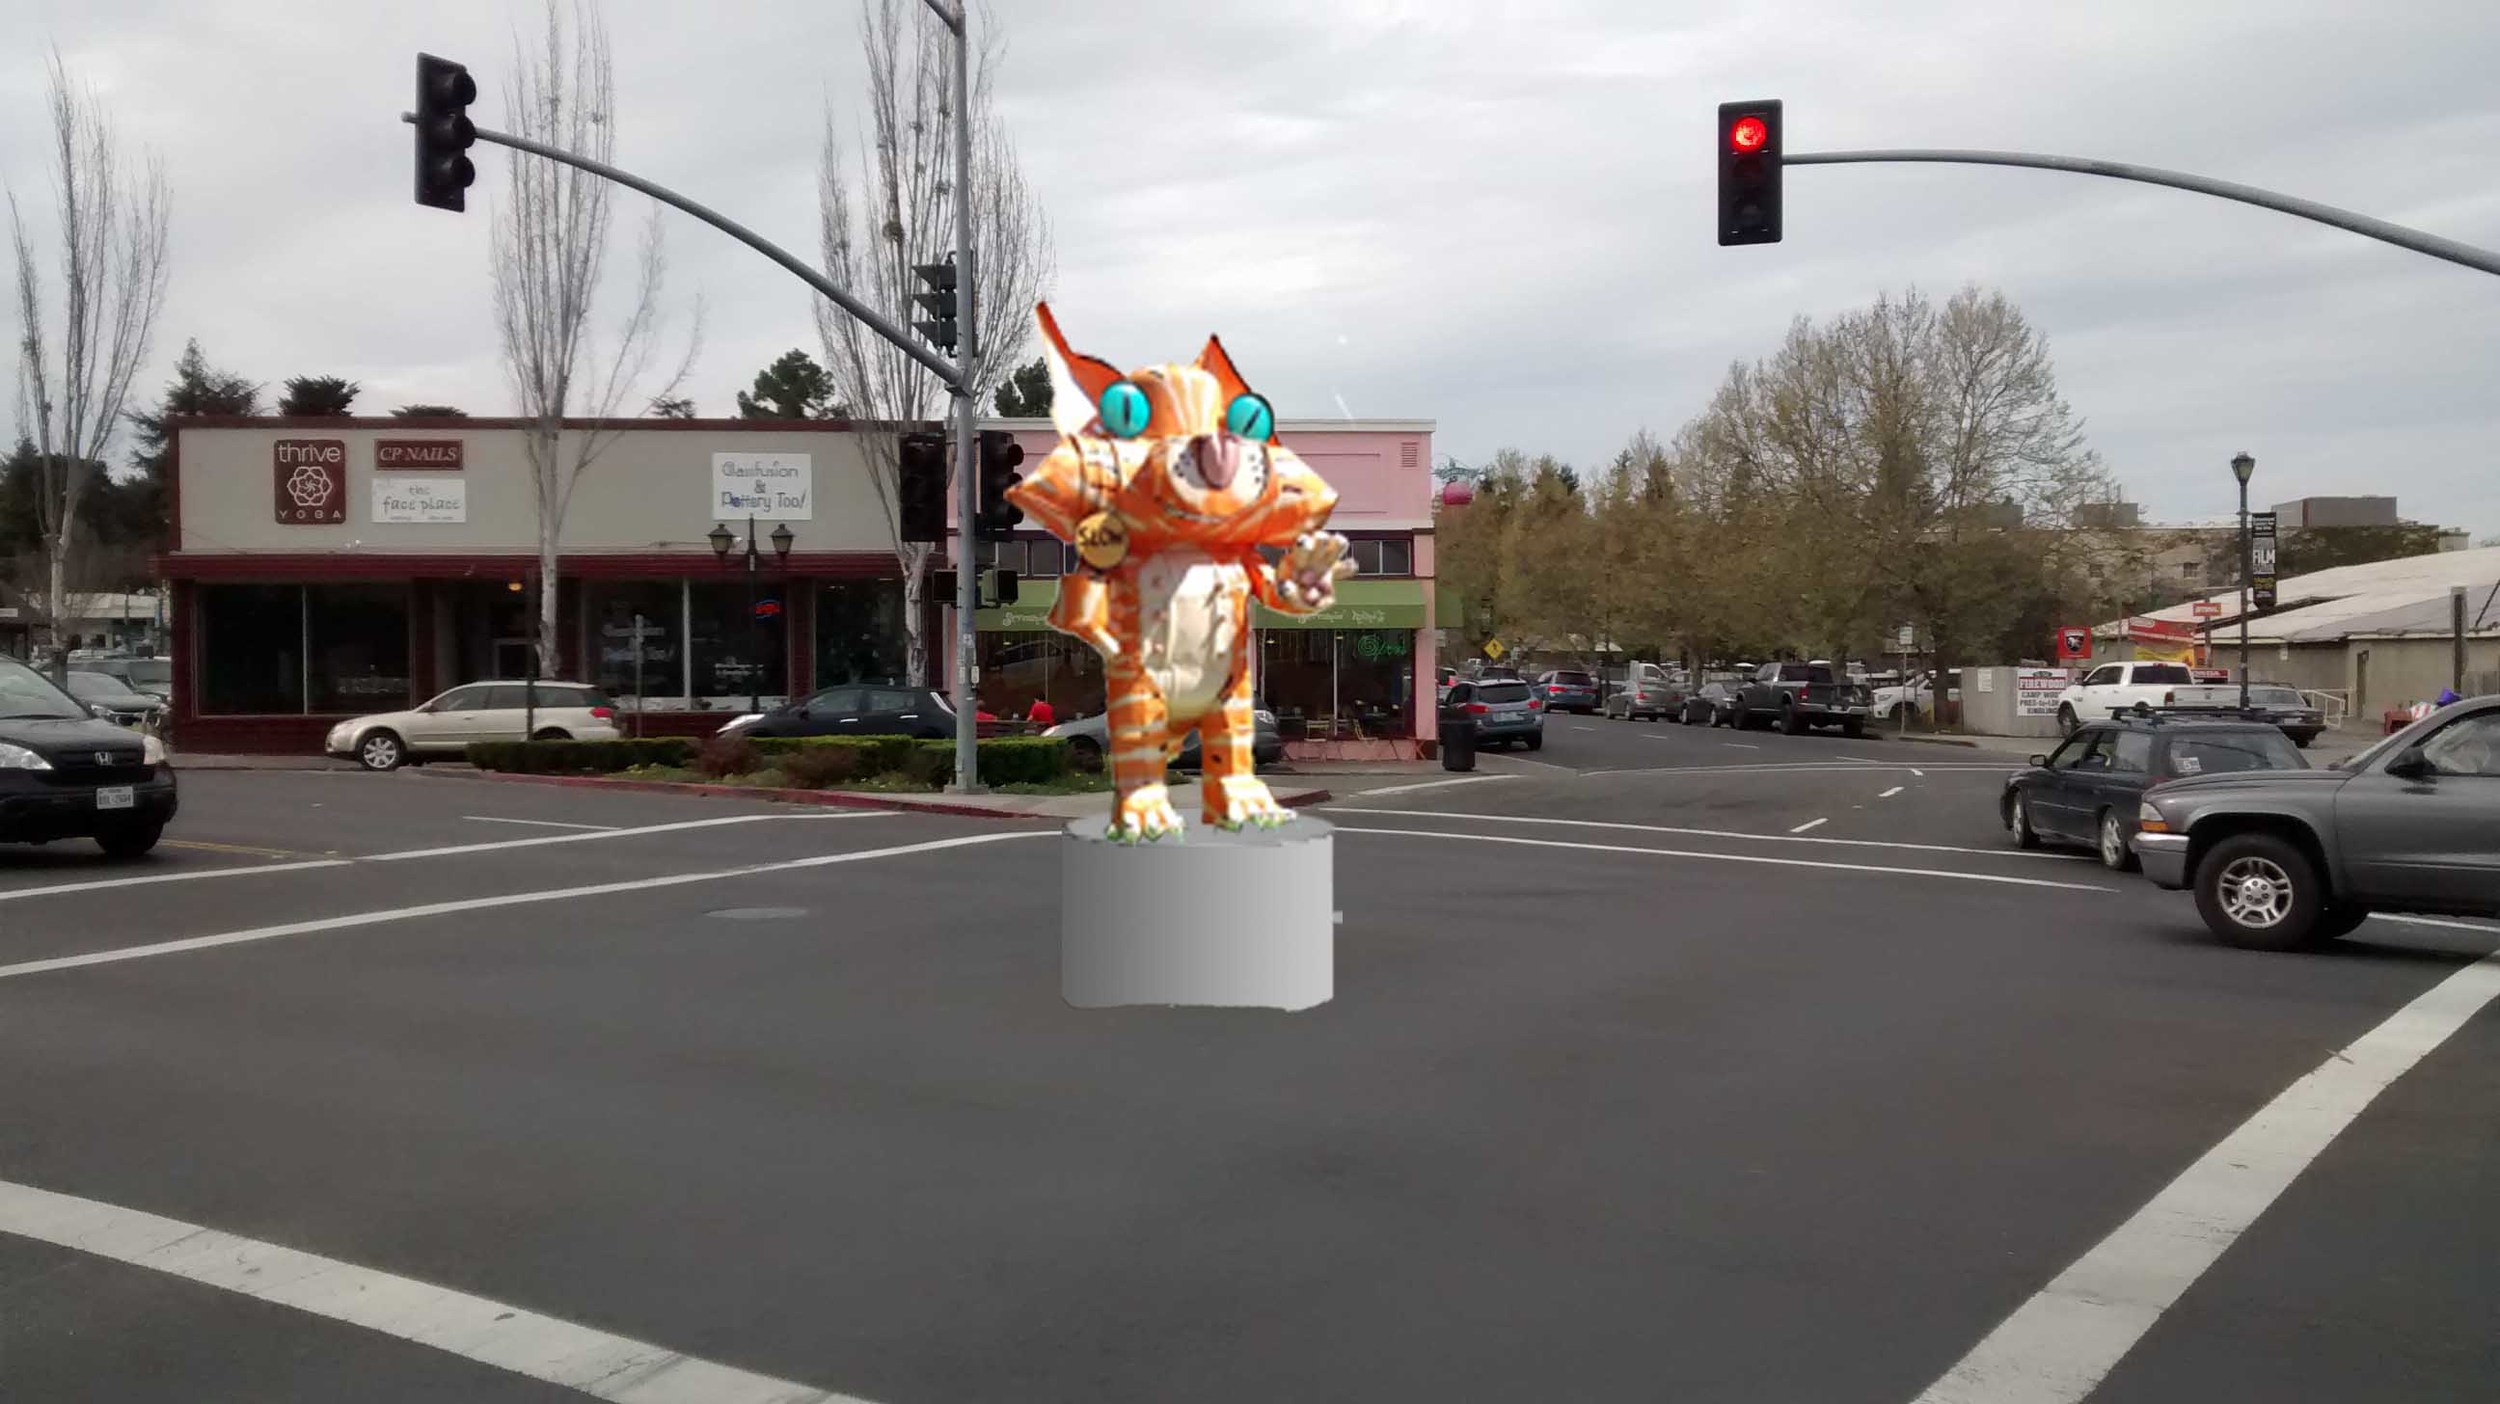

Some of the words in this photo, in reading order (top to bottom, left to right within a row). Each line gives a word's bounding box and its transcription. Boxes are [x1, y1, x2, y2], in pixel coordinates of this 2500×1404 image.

[278, 443, 341, 463] thrive
[380, 447, 402, 461] CP
[404, 447, 458, 461] NAILS
[409, 484, 431, 495] the
[754, 479, 766, 494] &
[382, 496, 416, 514] face
[721, 491, 771, 512] Pottery
[2252, 549, 2276, 564] FILM
[2019, 679, 2066, 689] FIREWOOD
